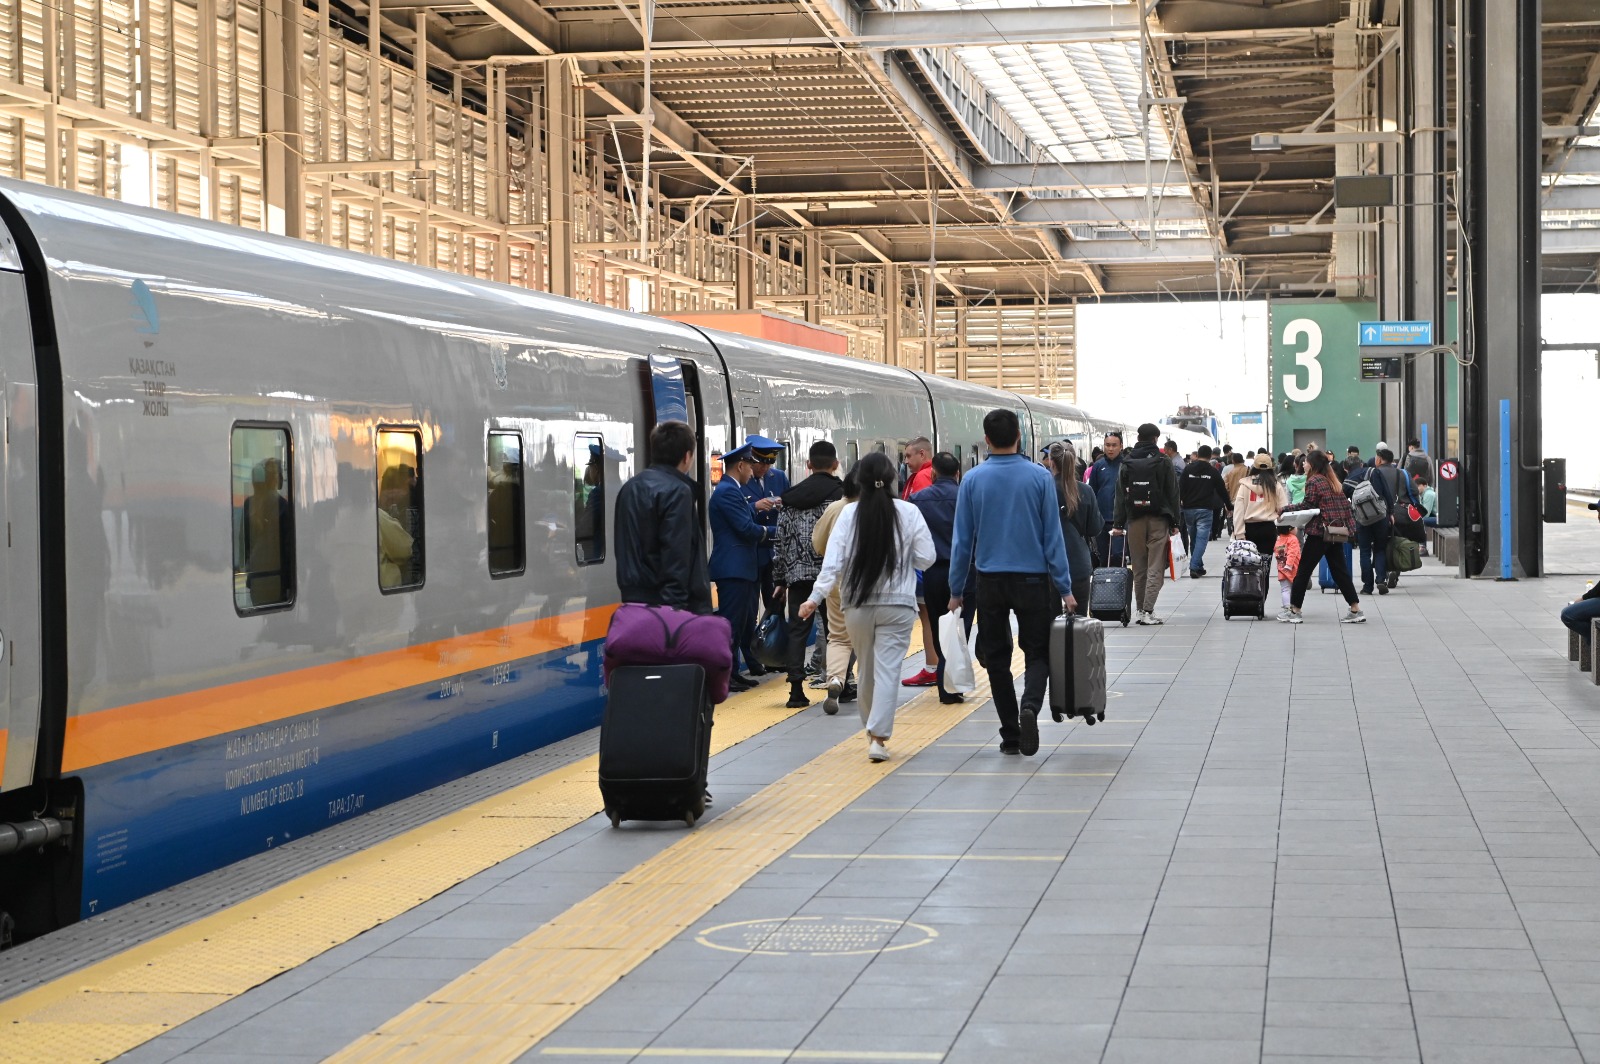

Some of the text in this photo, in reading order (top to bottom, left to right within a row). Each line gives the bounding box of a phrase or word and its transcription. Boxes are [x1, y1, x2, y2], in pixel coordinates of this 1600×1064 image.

[129, 358, 176, 378] ҚАЗАҚСТАН
[1283, 318, 1322, 402] 3
[143, 381, 166, 397] ТЕМІР
[143, 400, 169, 416] ЖОЛЫ
[226, 717, 319, 760] ЖАТЫН ОРЫНДАР САНЫ: 18
[225, 761, 264, 791] КОЛИЧЕСТВО
[241, 779, 304, 816] NUMBER OF BEDS: 18
